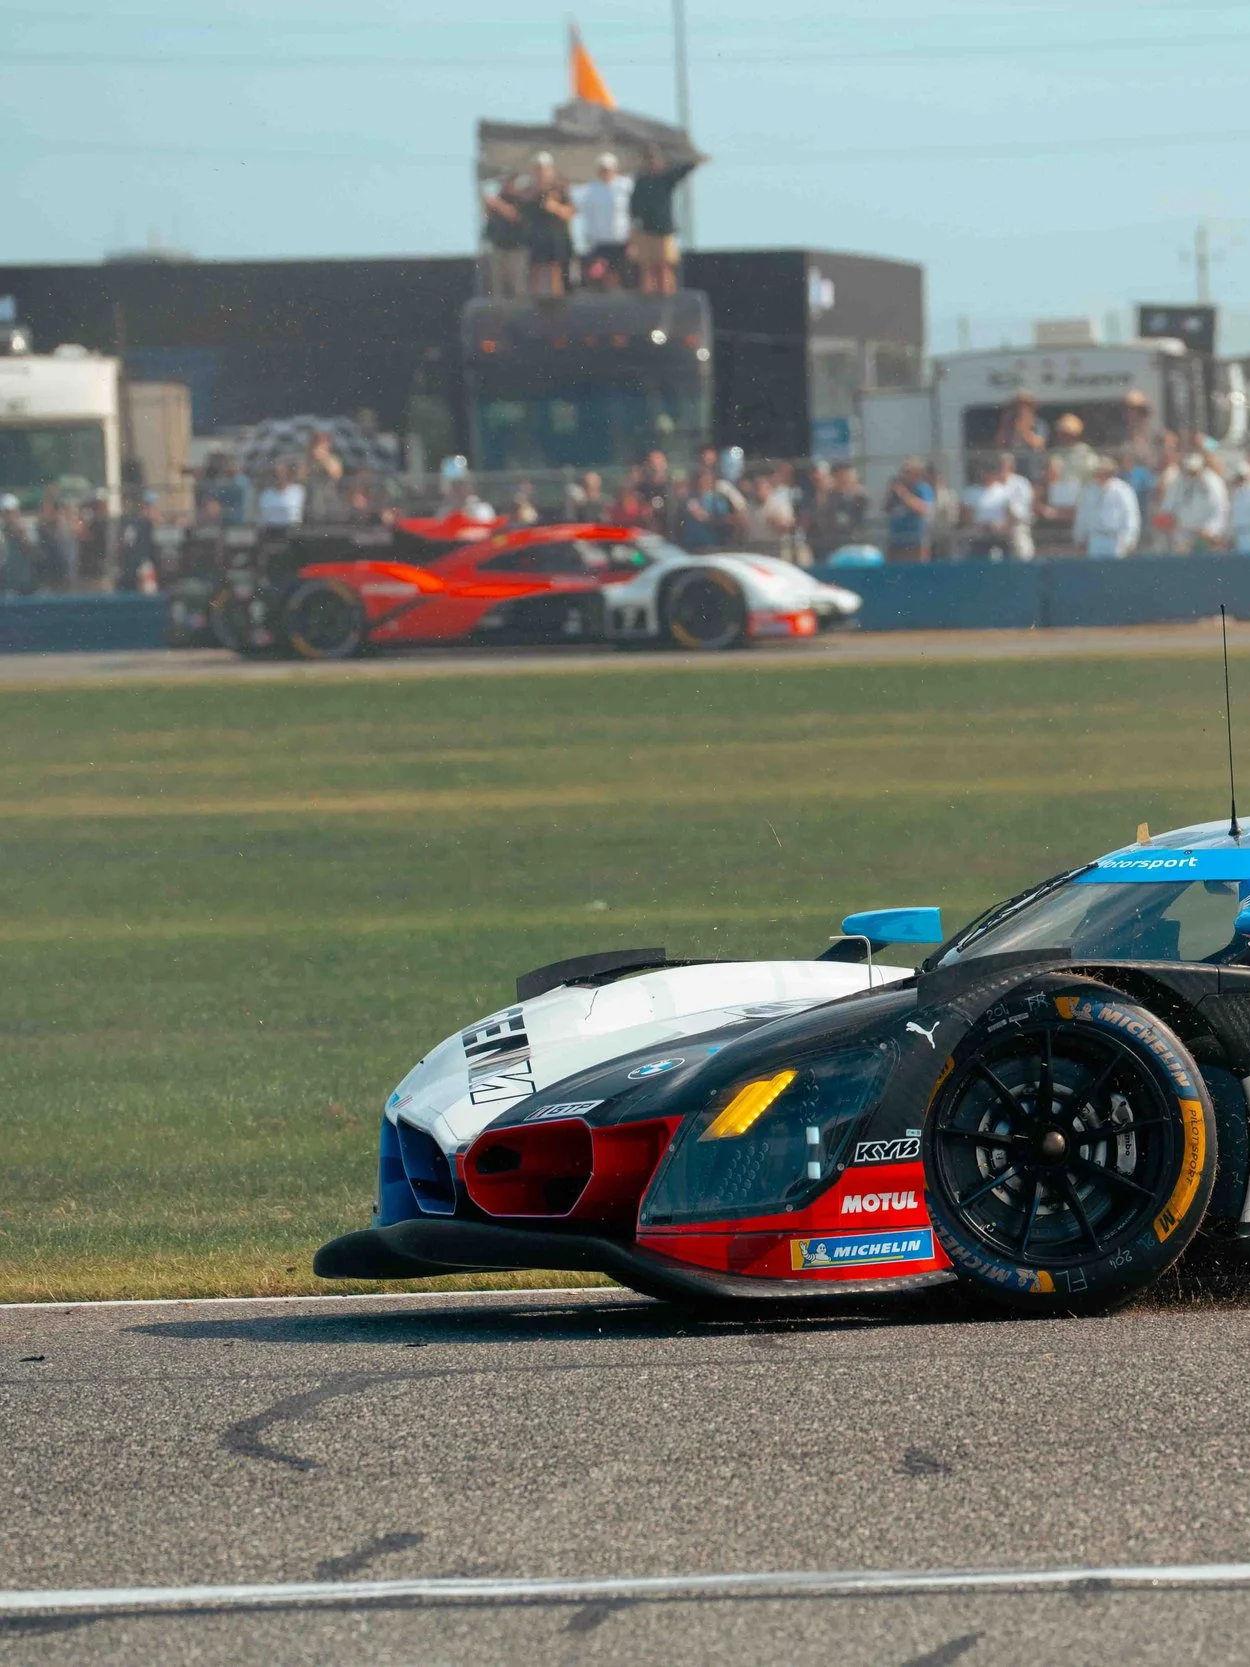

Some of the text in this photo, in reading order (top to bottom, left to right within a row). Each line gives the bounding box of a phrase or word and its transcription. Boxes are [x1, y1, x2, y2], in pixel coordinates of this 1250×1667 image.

[1099, 1006, 1192, 1087] MICHELIN
[547, 1102, 596, 1115] GTP
[854, 1137, 921, 1163] KYB
[1186, 1146, 1200, 1187] SPORT
[841, 1190, 919, 1214] MOTUL
[1159, 1208, 1177, 1234] M
[833, 1239, 921, 1258] MICHELIN
